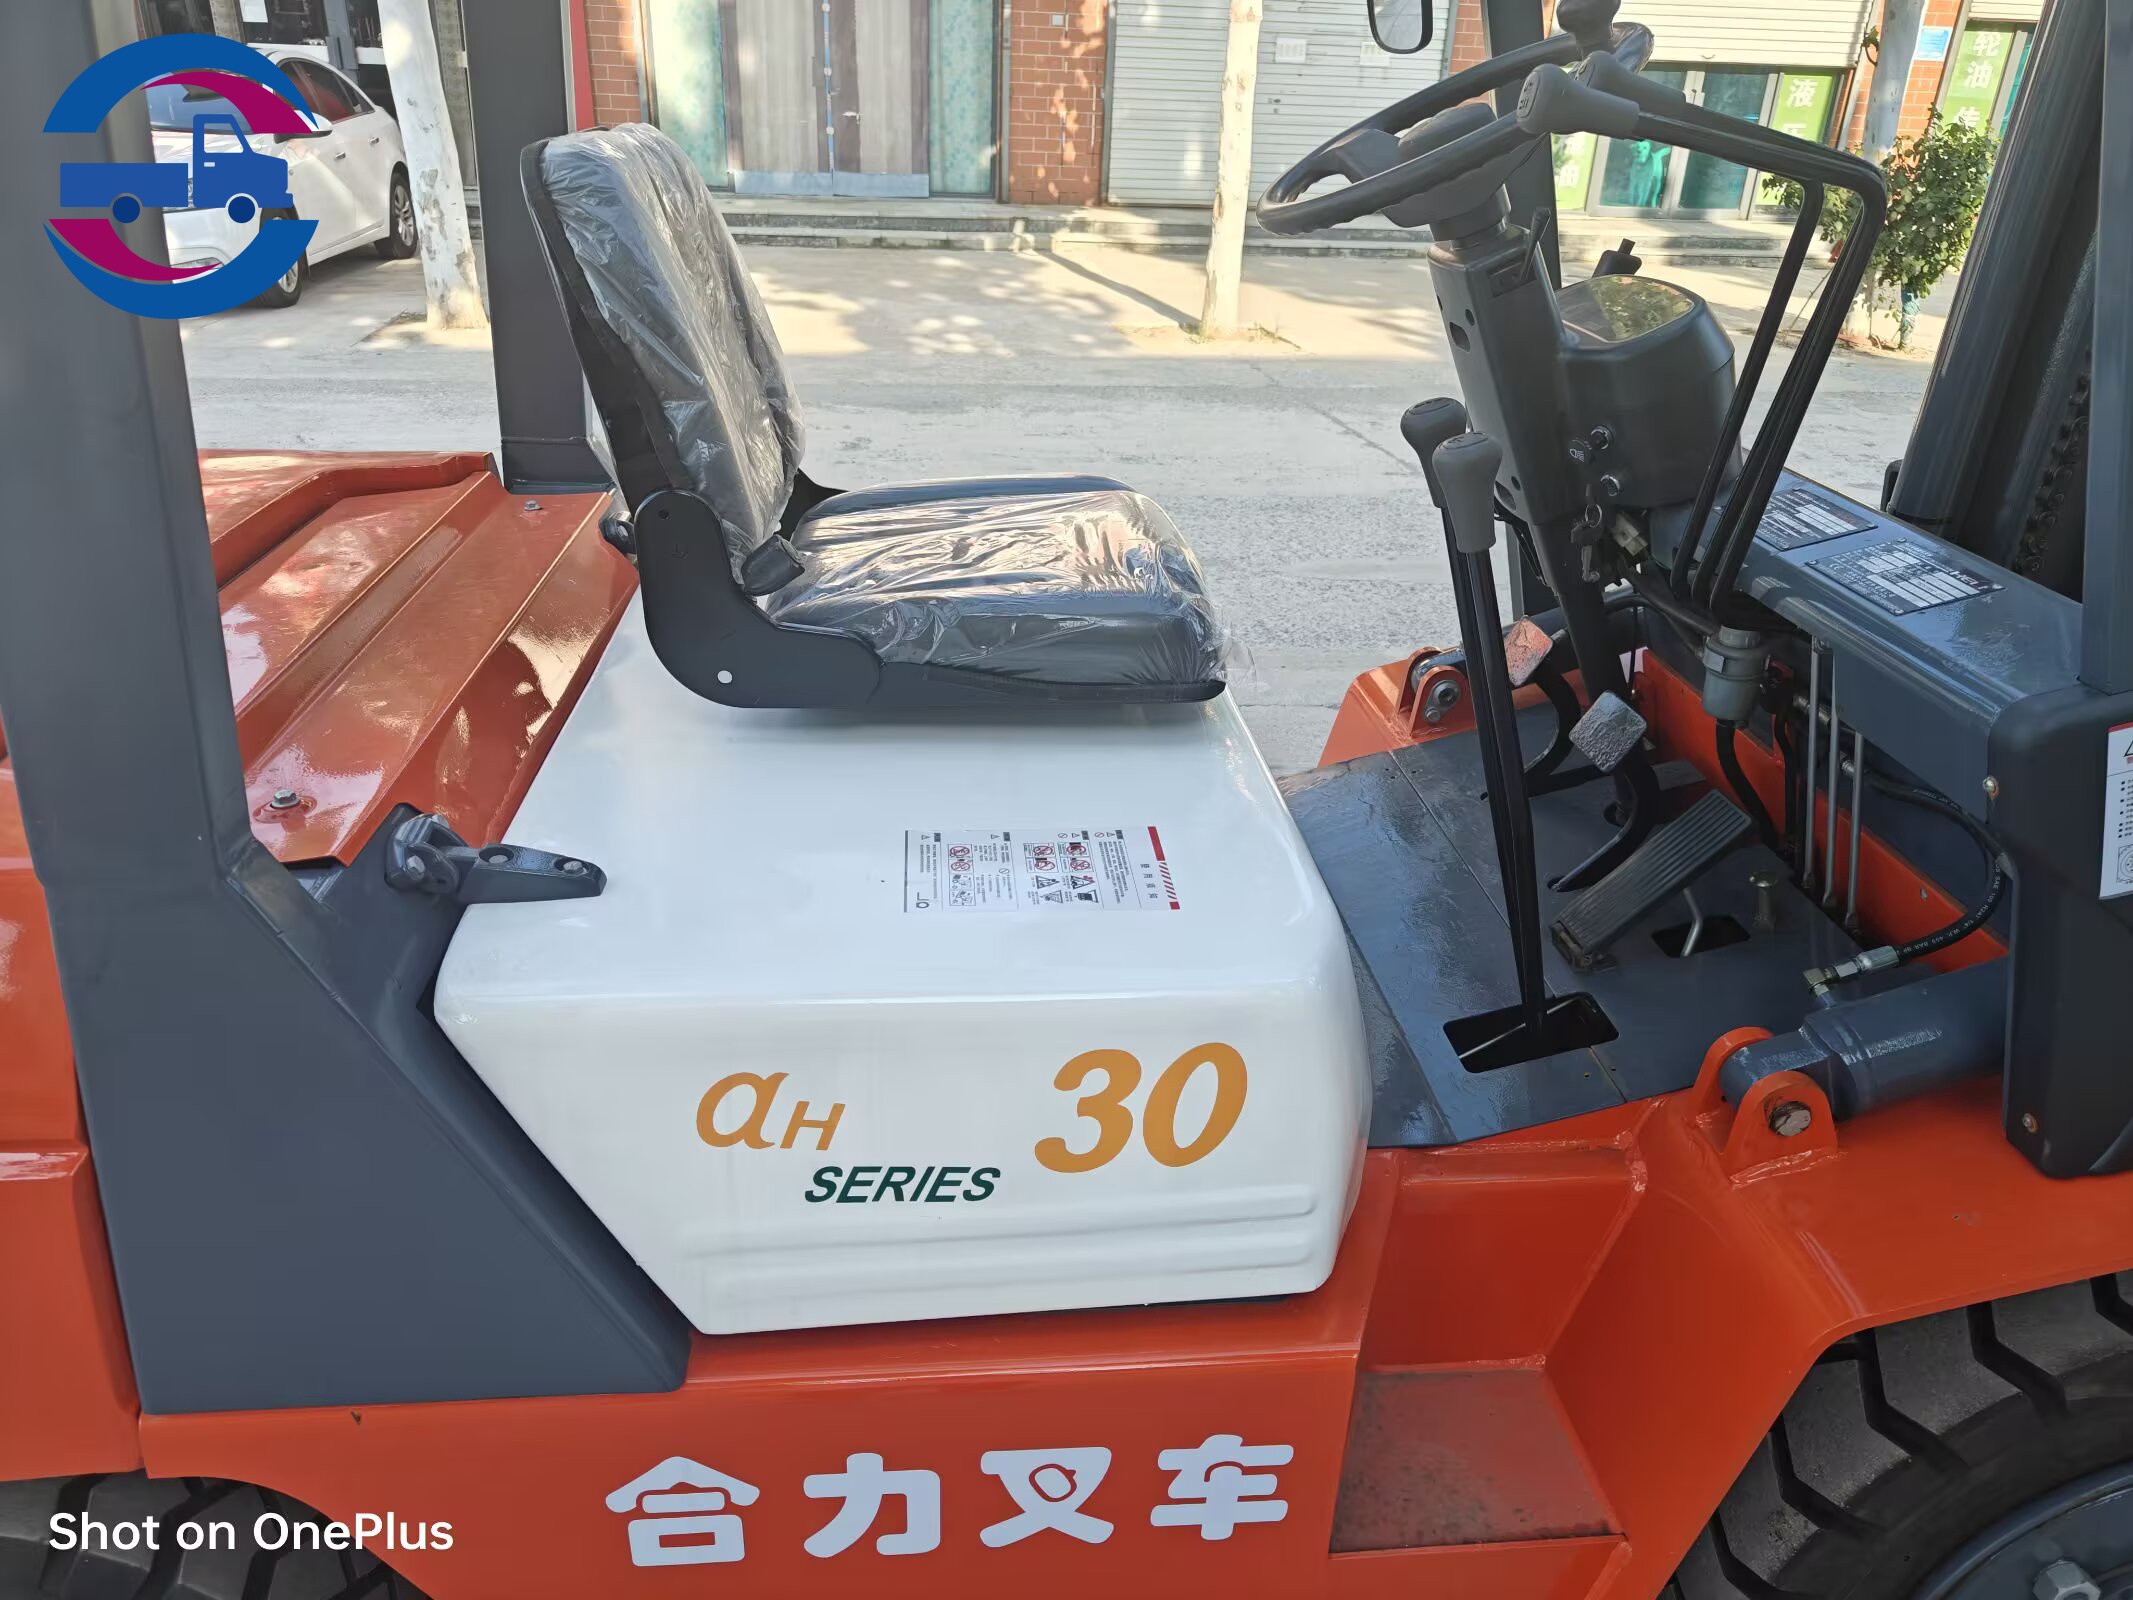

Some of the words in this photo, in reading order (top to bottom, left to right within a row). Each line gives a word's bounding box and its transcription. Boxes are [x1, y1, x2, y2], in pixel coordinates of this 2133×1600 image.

[1034, 1042, 1248, 1173] 30
[804, 1166, 1000, 1203] SERIES
[605, 1434, 1294, 1567] 合力叉车
